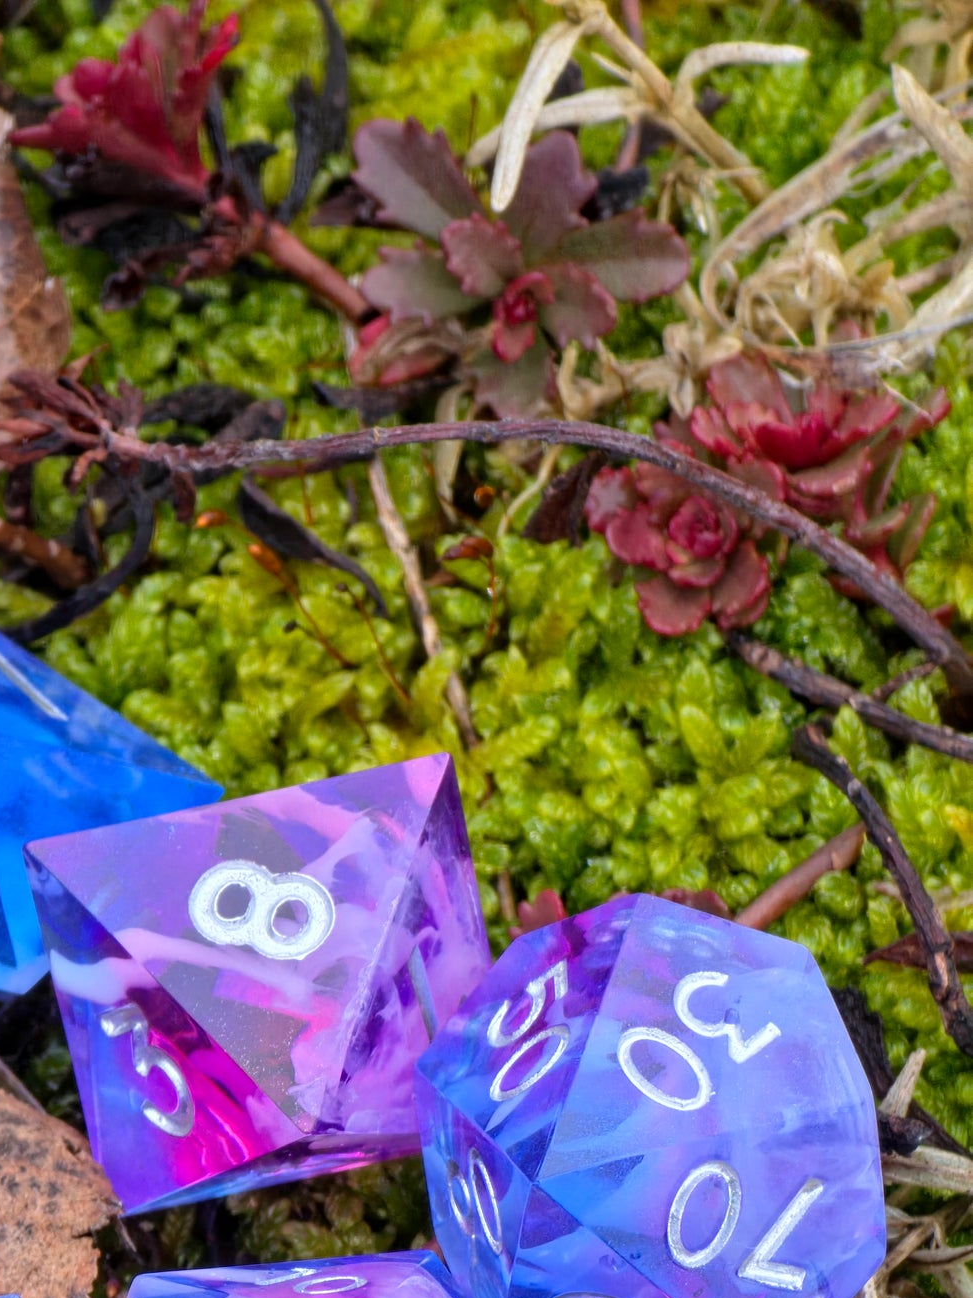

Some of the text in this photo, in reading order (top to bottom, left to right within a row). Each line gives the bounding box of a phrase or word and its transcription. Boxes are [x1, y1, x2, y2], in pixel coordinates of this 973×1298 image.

[188, 859, 336, 961] 8
[487, 960, 571, 1102] 50
[617, 970, 783, 1112] 30
[255, 1267, 369, 1295] 10
[666, 1159, 824, 1292] 70
